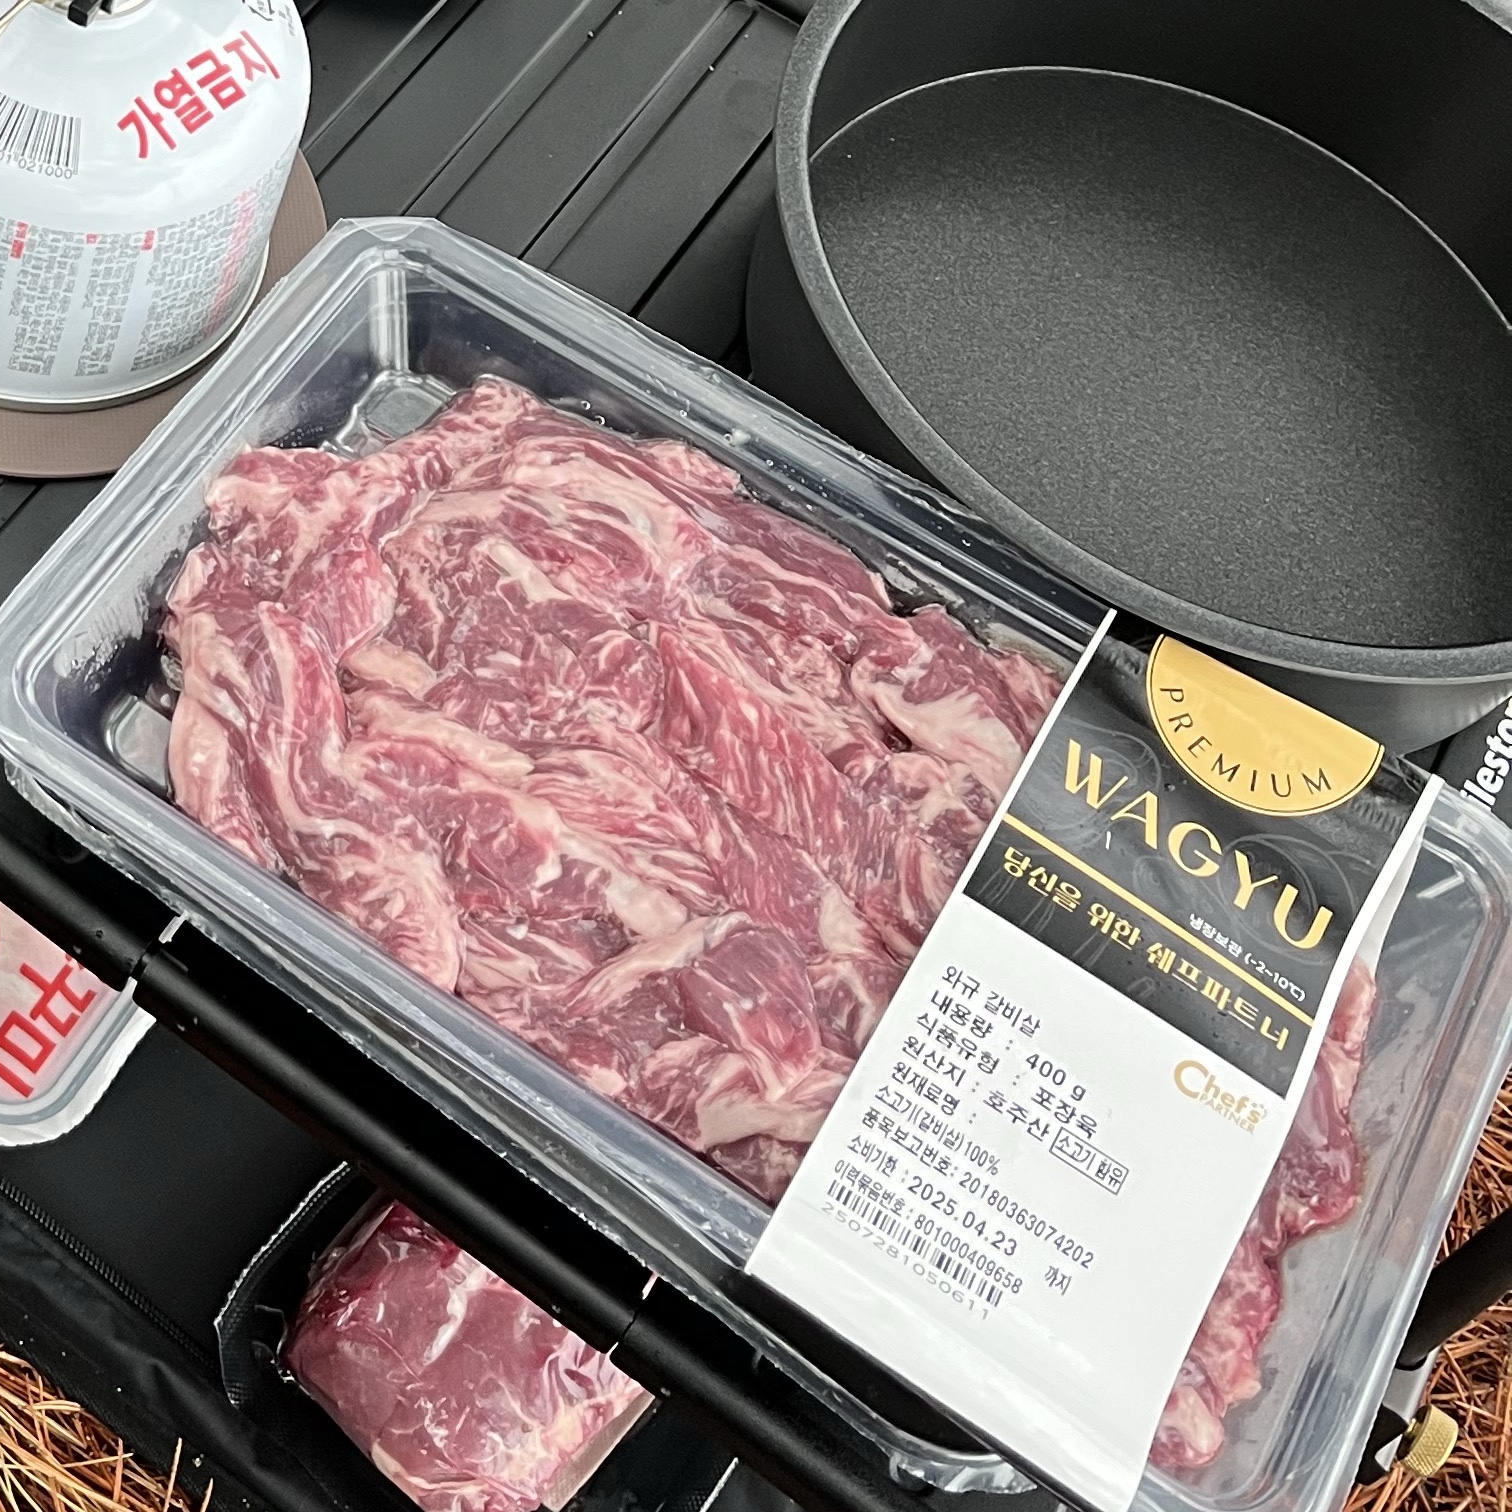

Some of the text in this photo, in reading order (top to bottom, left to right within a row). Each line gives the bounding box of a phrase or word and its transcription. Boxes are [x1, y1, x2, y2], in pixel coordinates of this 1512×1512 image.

[117, 30, 281, 159] 가열금지
[1160, 688, 1332, 798] PREMIUM
[1064, 738, 1334, 951] WAGYU
[1002, 846, 1083, 913] 당신을
[1087, 901, 1141, 951] 위한
[1189, 913, 1243, 958] 냉장보관
[931, 990, 1087, 1102] 내용량 400 g
[942, 965, 1041, 1038] 와규 갈비살
[891, 1061, 961, 1117] 원재료명
[902, 1035, 1124, 1189] 원산지 호주산 소고기 함유
[917, 1012, 1098, 1140] 식품유형 포장육
[1199, 1092, 1256, 1135] PARTNER
[847, 1134, 899, 1178] 소비기한
[1044, 1265, 1073, 1296] 까지
[915, 1213, 1023, 1294] 801000409658
[959, 1171, 1095, 1270] 20180363074202
